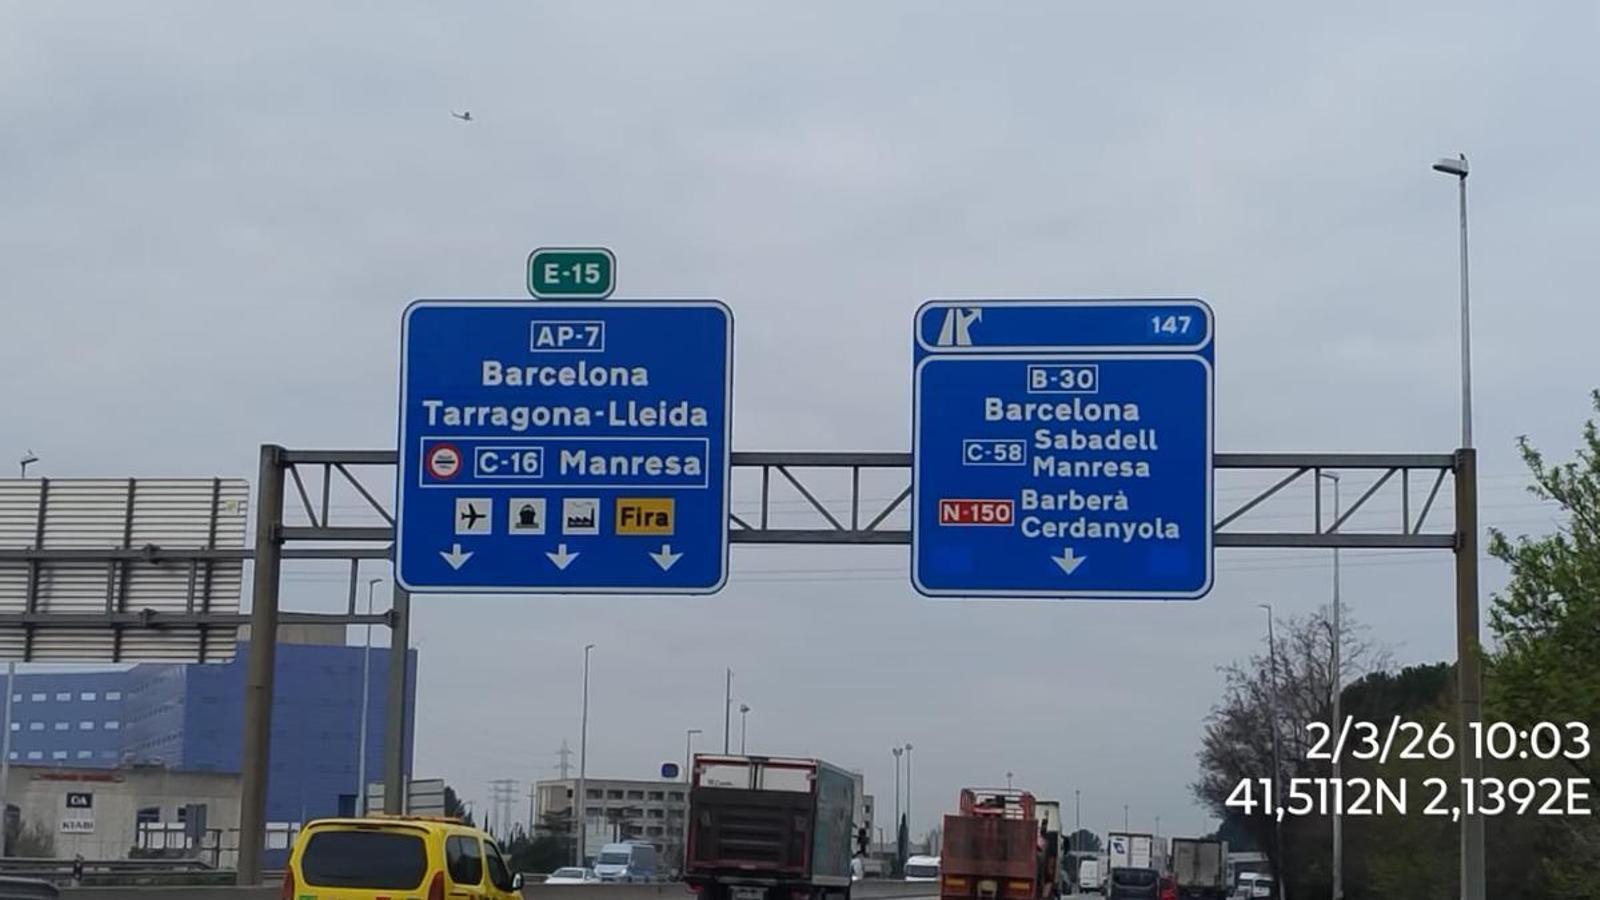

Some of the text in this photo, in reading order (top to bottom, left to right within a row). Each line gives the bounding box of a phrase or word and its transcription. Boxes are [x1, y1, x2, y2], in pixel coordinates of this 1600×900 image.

[544, 263, 600, 284] E-15
[1152, 316, 1191, 334] 147
[536, 327, 599, 347] AP-7
[482, 361, 648, 387] Barcelona
[1031, 370, 1094, 388] B-30
[423, 400, 708, 431] Tarragona-Lleida
[985, 398, 1140, 421] Barcelona
[1035, 429, 1158, 450] Sabadell
[478, 450, 701, 476] C-16 Manresa
[967, 444, 1022, 461] C-58
[1033, 457, 1150, 478] Manresa
[1022, 490, 1128, 511] Barberà
[620, 507, 669, 527] Fira
[943, 505, 1011, 521] N-150
[1021, 517, 1180, 542] Cerdanyola
